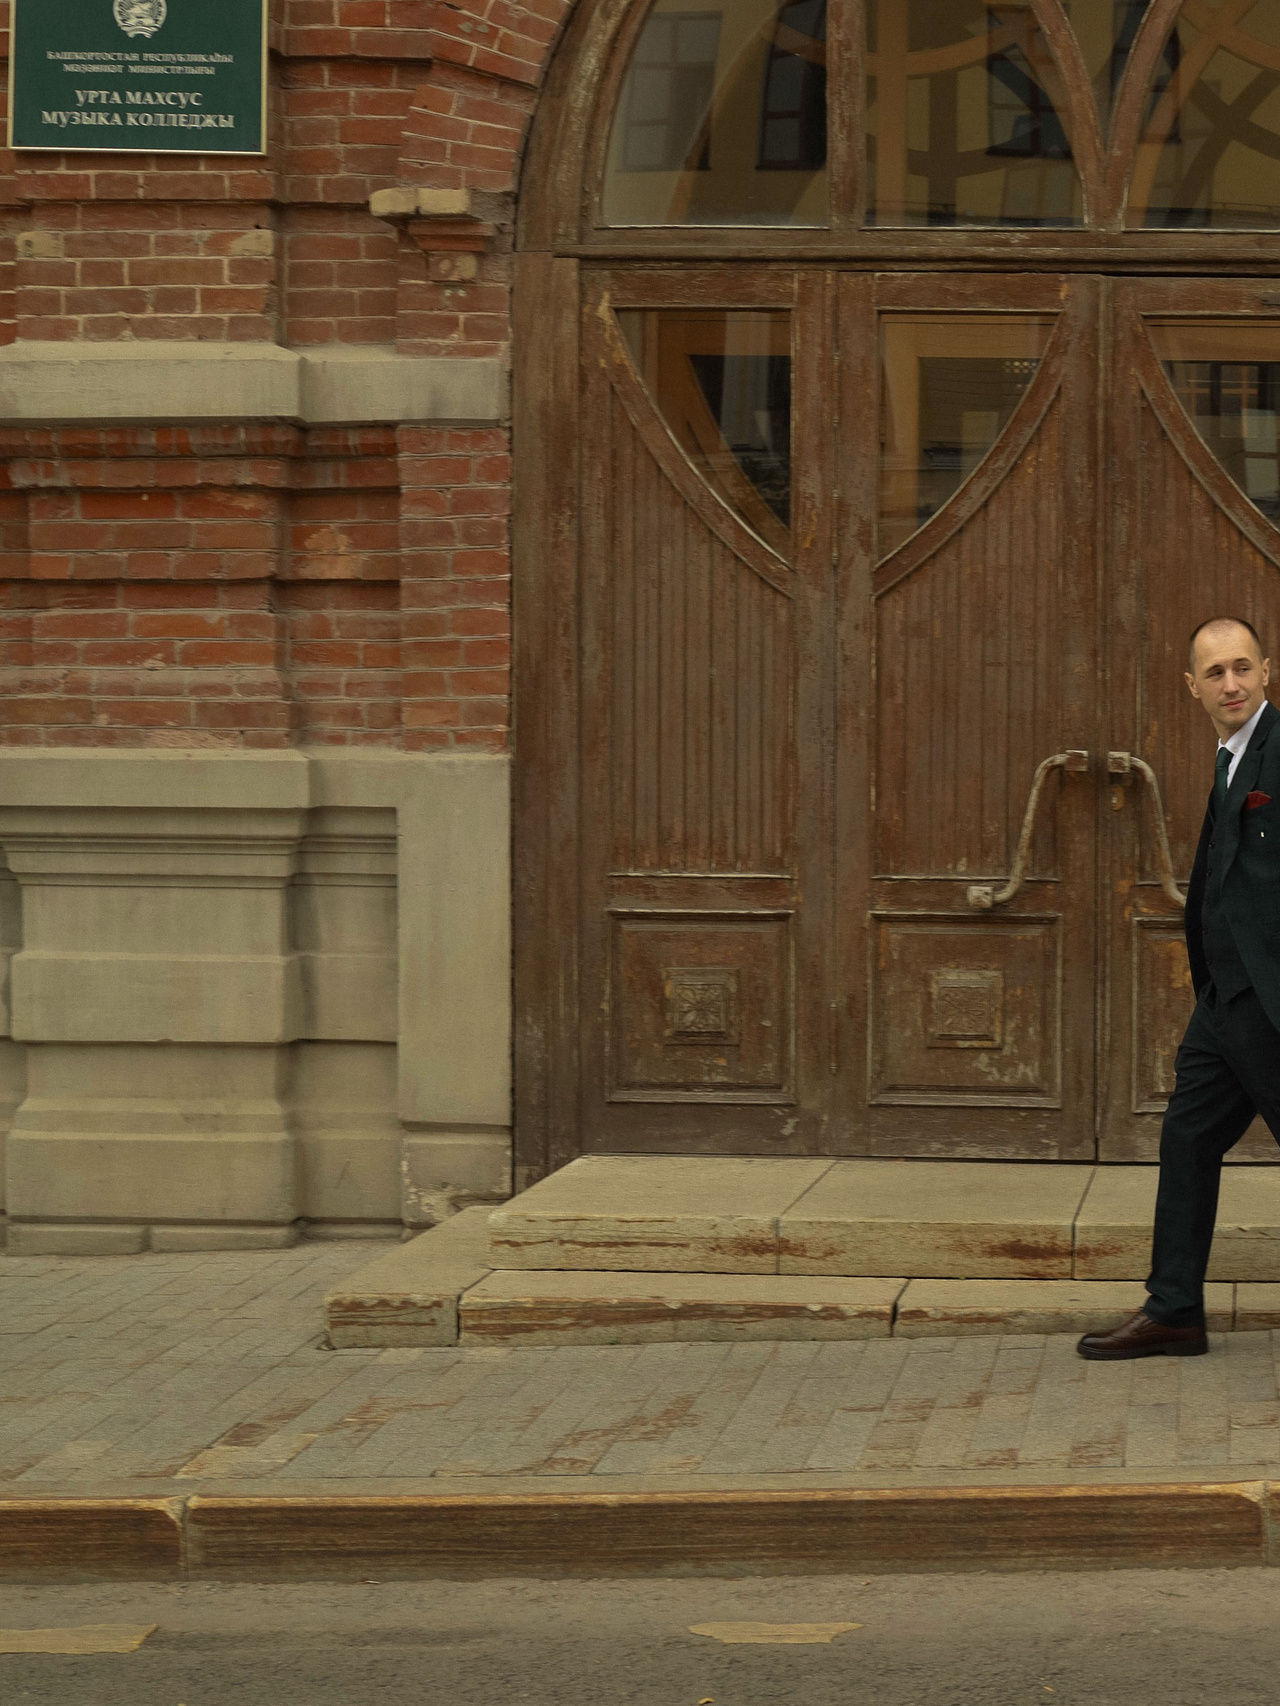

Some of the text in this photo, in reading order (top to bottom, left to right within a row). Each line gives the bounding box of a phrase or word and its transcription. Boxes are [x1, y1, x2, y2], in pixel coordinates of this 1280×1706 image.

[75, 90, 203, 108] УРТА МАХСУС
[41, 110, 235, 129] МУЗЫКА КОЛЛЕДЖЫ
